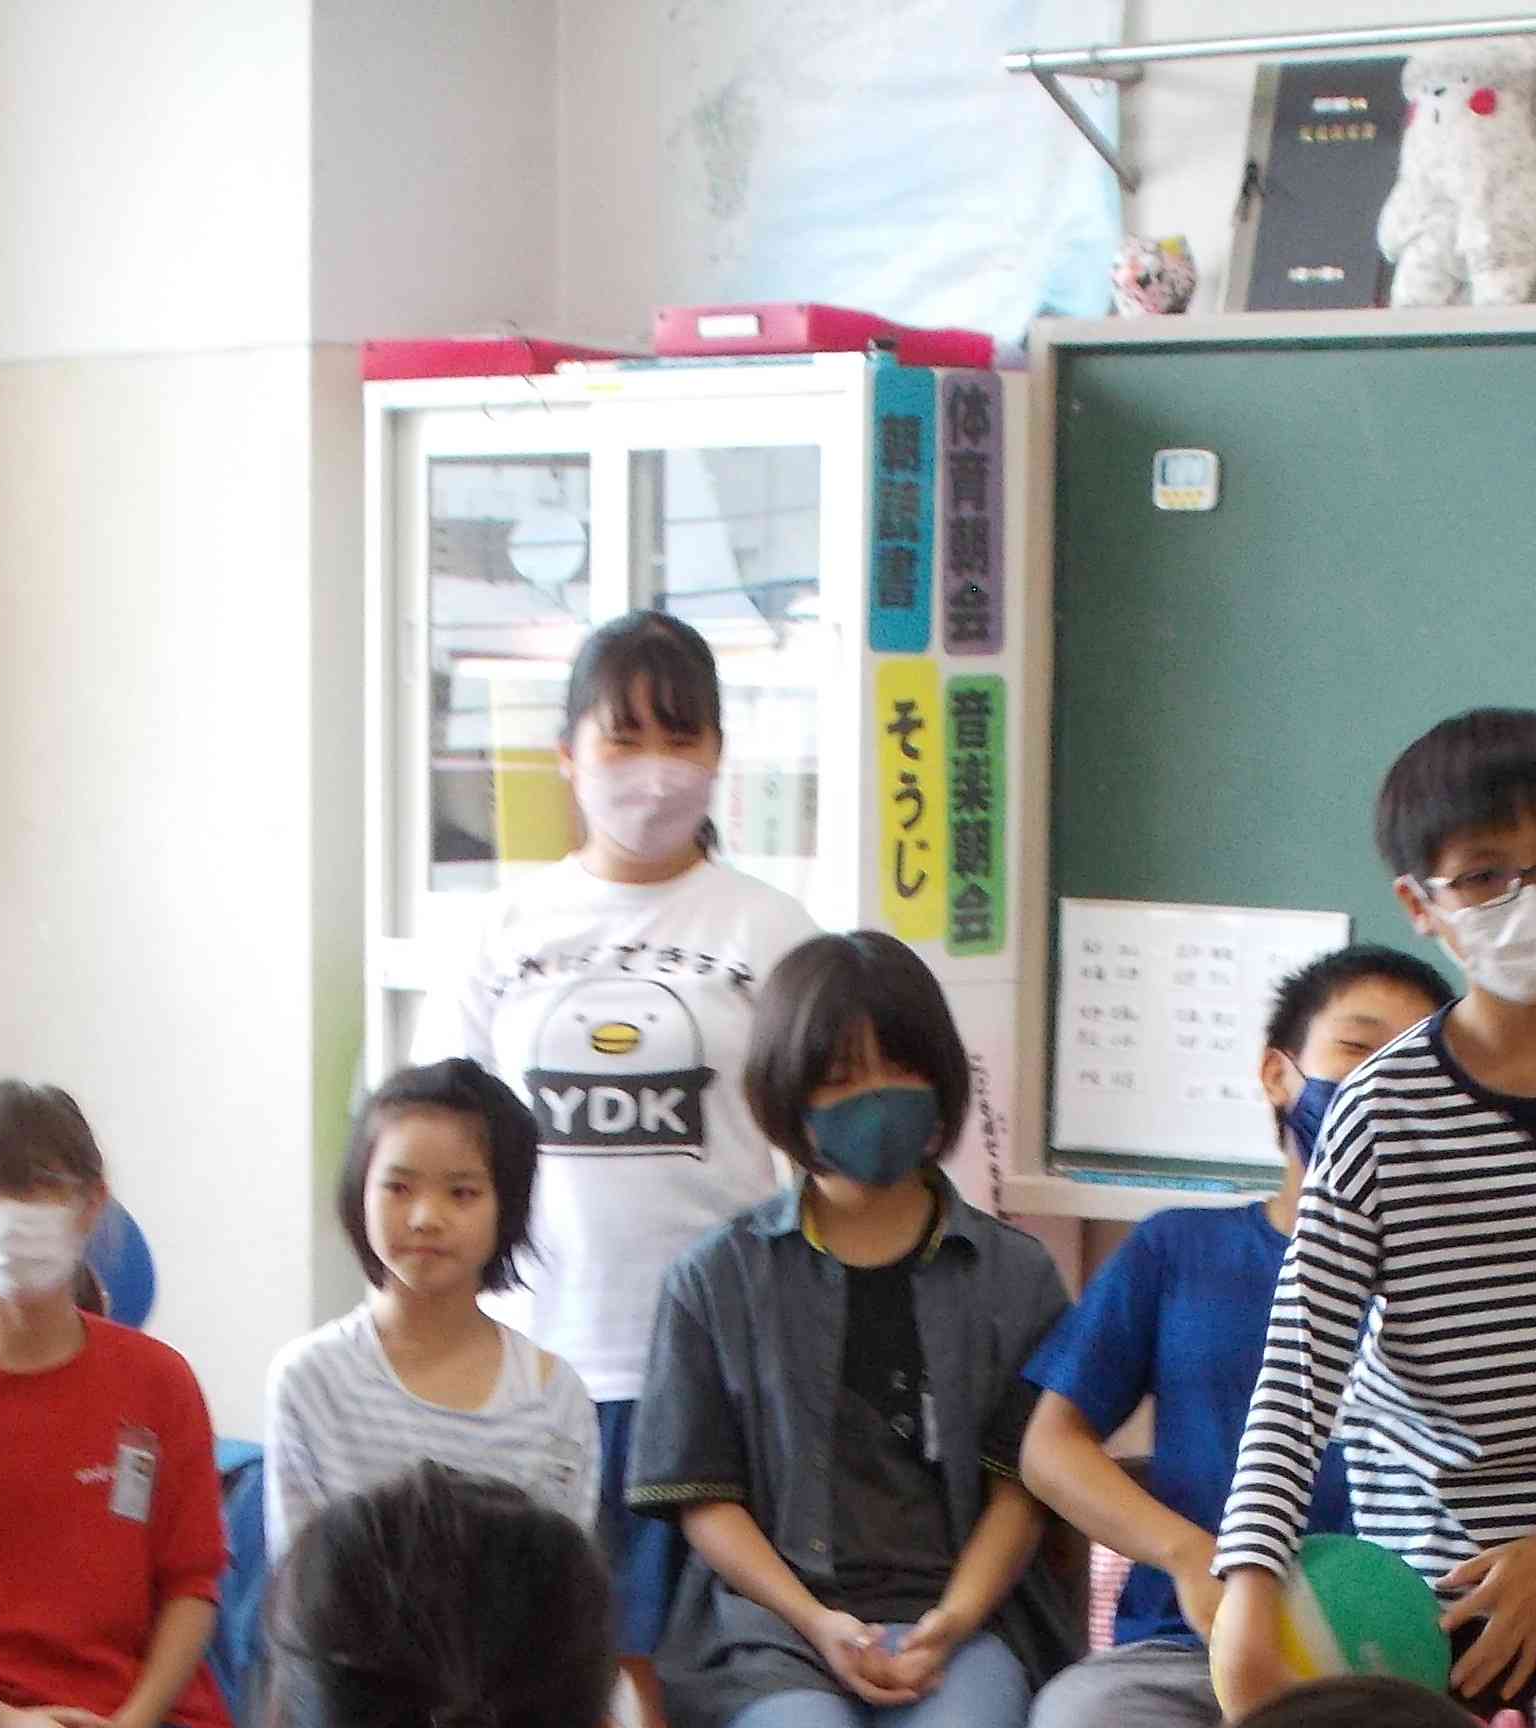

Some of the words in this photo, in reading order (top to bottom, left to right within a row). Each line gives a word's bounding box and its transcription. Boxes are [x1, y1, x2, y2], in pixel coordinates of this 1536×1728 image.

[884, 701, 930, 899] そうじ
[538, 1085, 689, 1136] YDK
